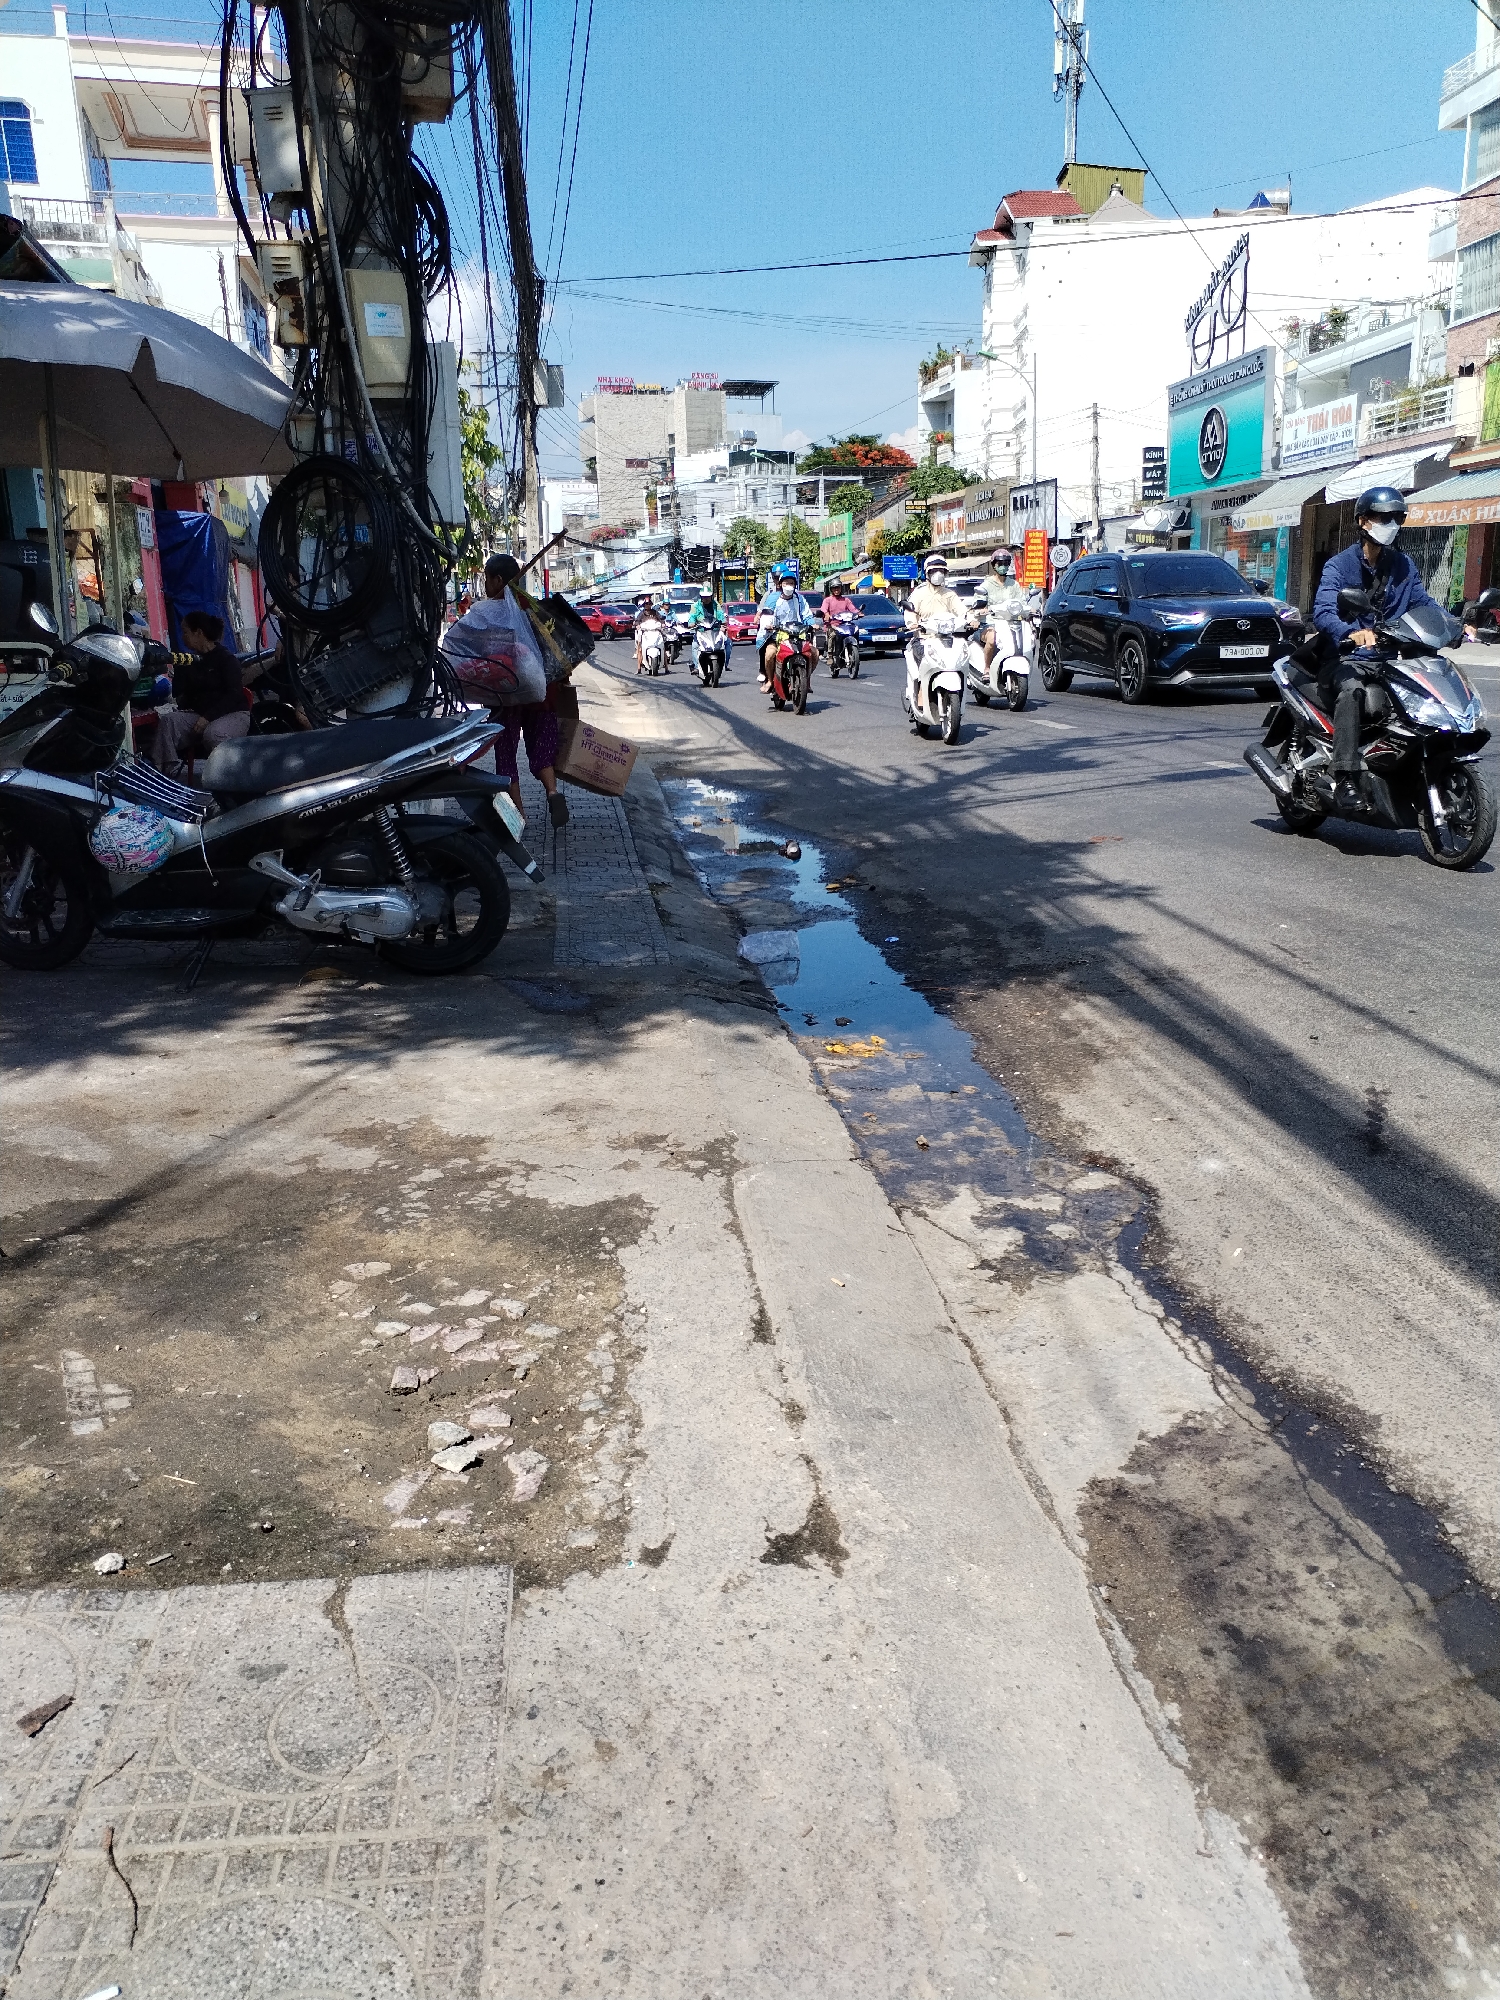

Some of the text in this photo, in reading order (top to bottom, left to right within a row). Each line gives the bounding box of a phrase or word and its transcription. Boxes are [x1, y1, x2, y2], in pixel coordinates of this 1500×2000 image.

[598, 376, 613, 384] NHA
[1145, 450, 1163, 459] KÍNH
[1144, 488, 1163, 497] ANNA
[1424, 505, 1472, 523] XUÂN
[299, 786, 379, 819] AIR BLADE
